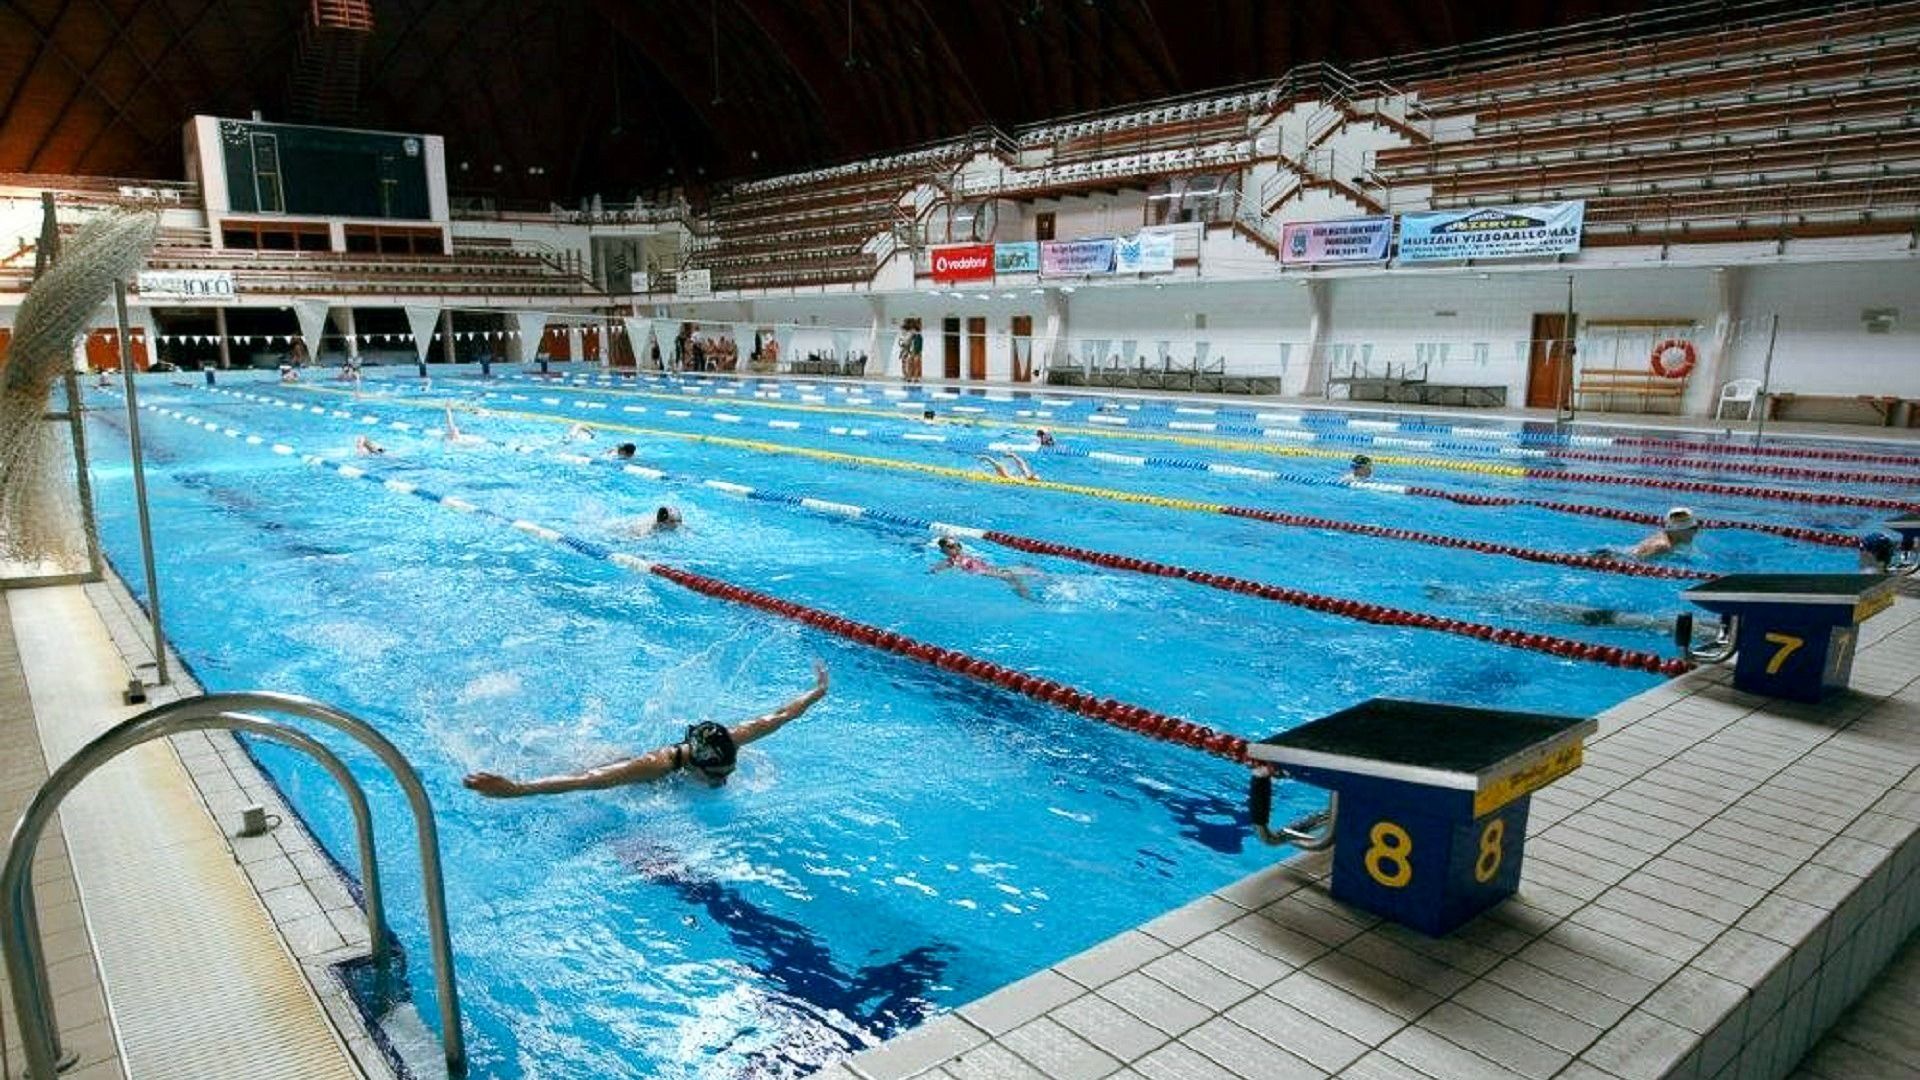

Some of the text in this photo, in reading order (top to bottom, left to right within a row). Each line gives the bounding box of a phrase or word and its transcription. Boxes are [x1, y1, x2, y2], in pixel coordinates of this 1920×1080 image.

[1765, 631, 1805, 674] 7
[1364, 821, 1413, 889] 8
[1475, 818, 1505, 884] 8
